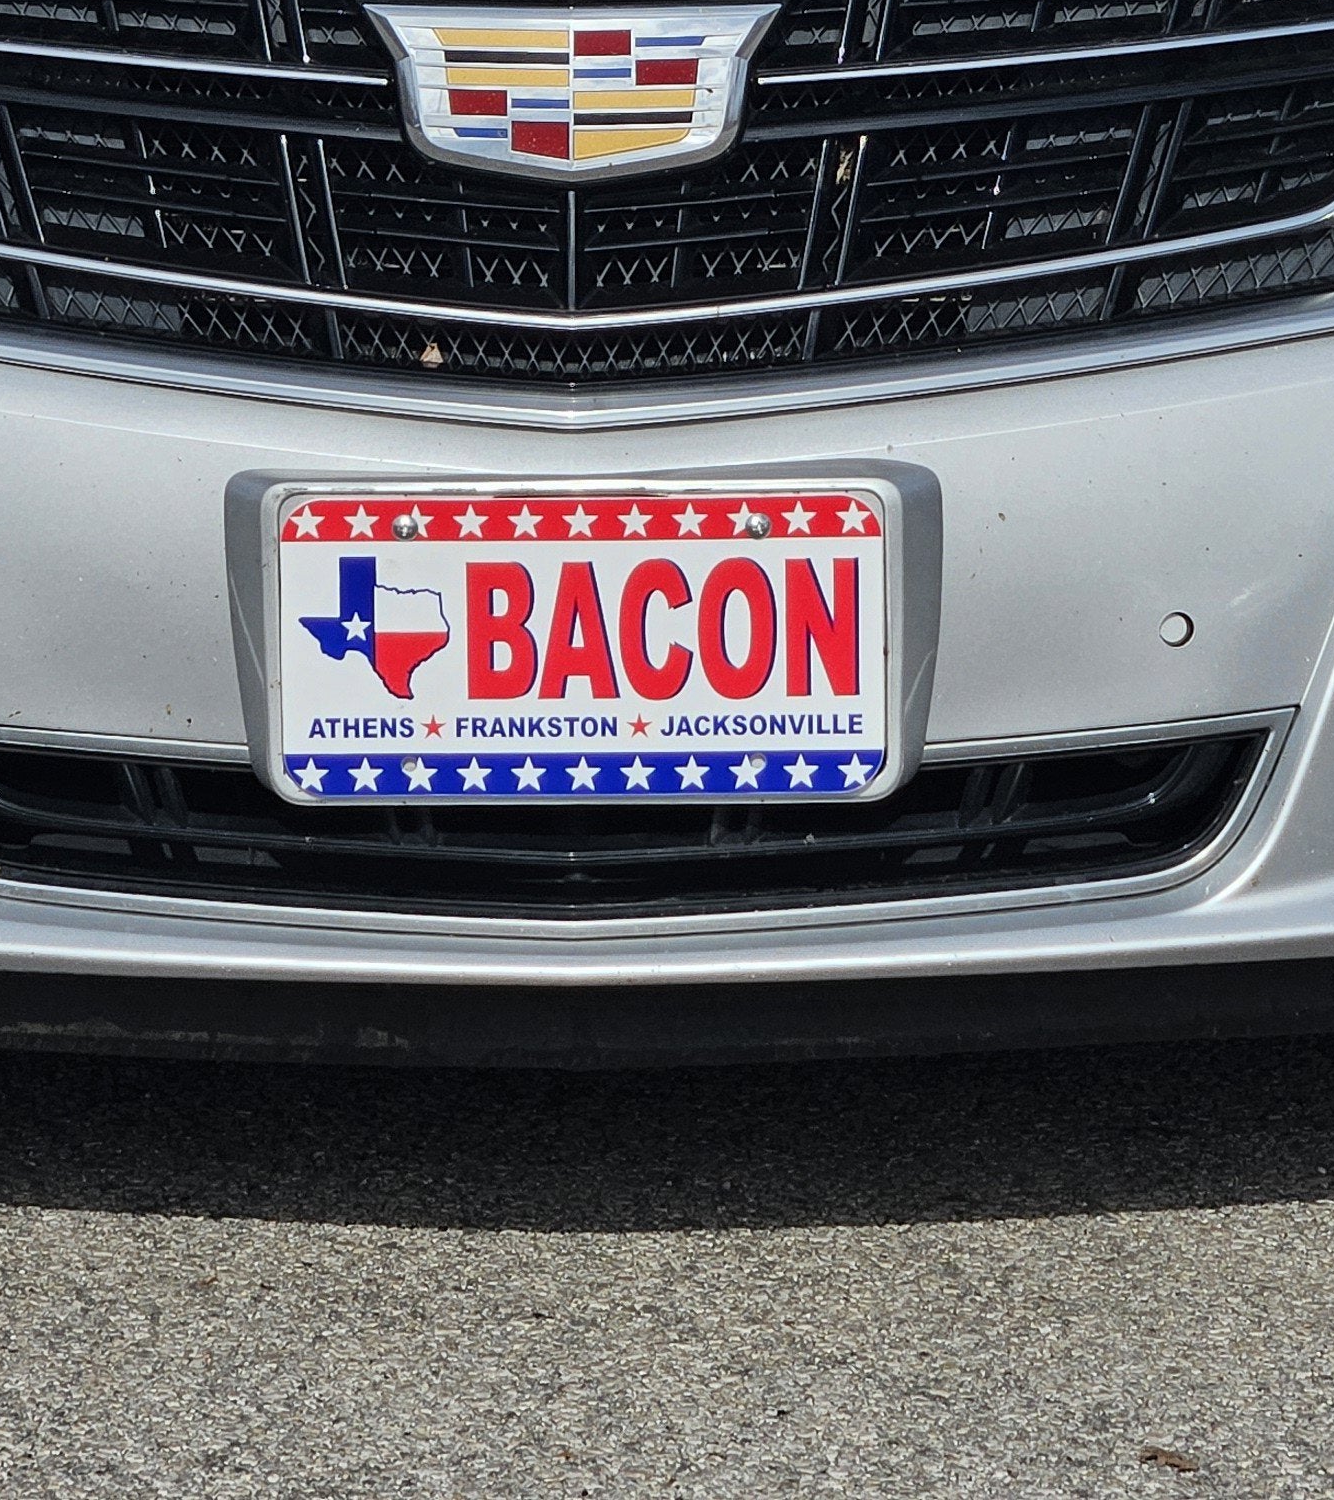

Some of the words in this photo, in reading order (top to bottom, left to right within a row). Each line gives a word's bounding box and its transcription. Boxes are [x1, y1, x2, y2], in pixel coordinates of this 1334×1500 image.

[466, 557, 861, 701] BACON
[308, 717, 416, 740] ATHENS
[455, 715, 619, 739] FRANKSTON
[659, 713, 864, 737] JACKSONVILLE
